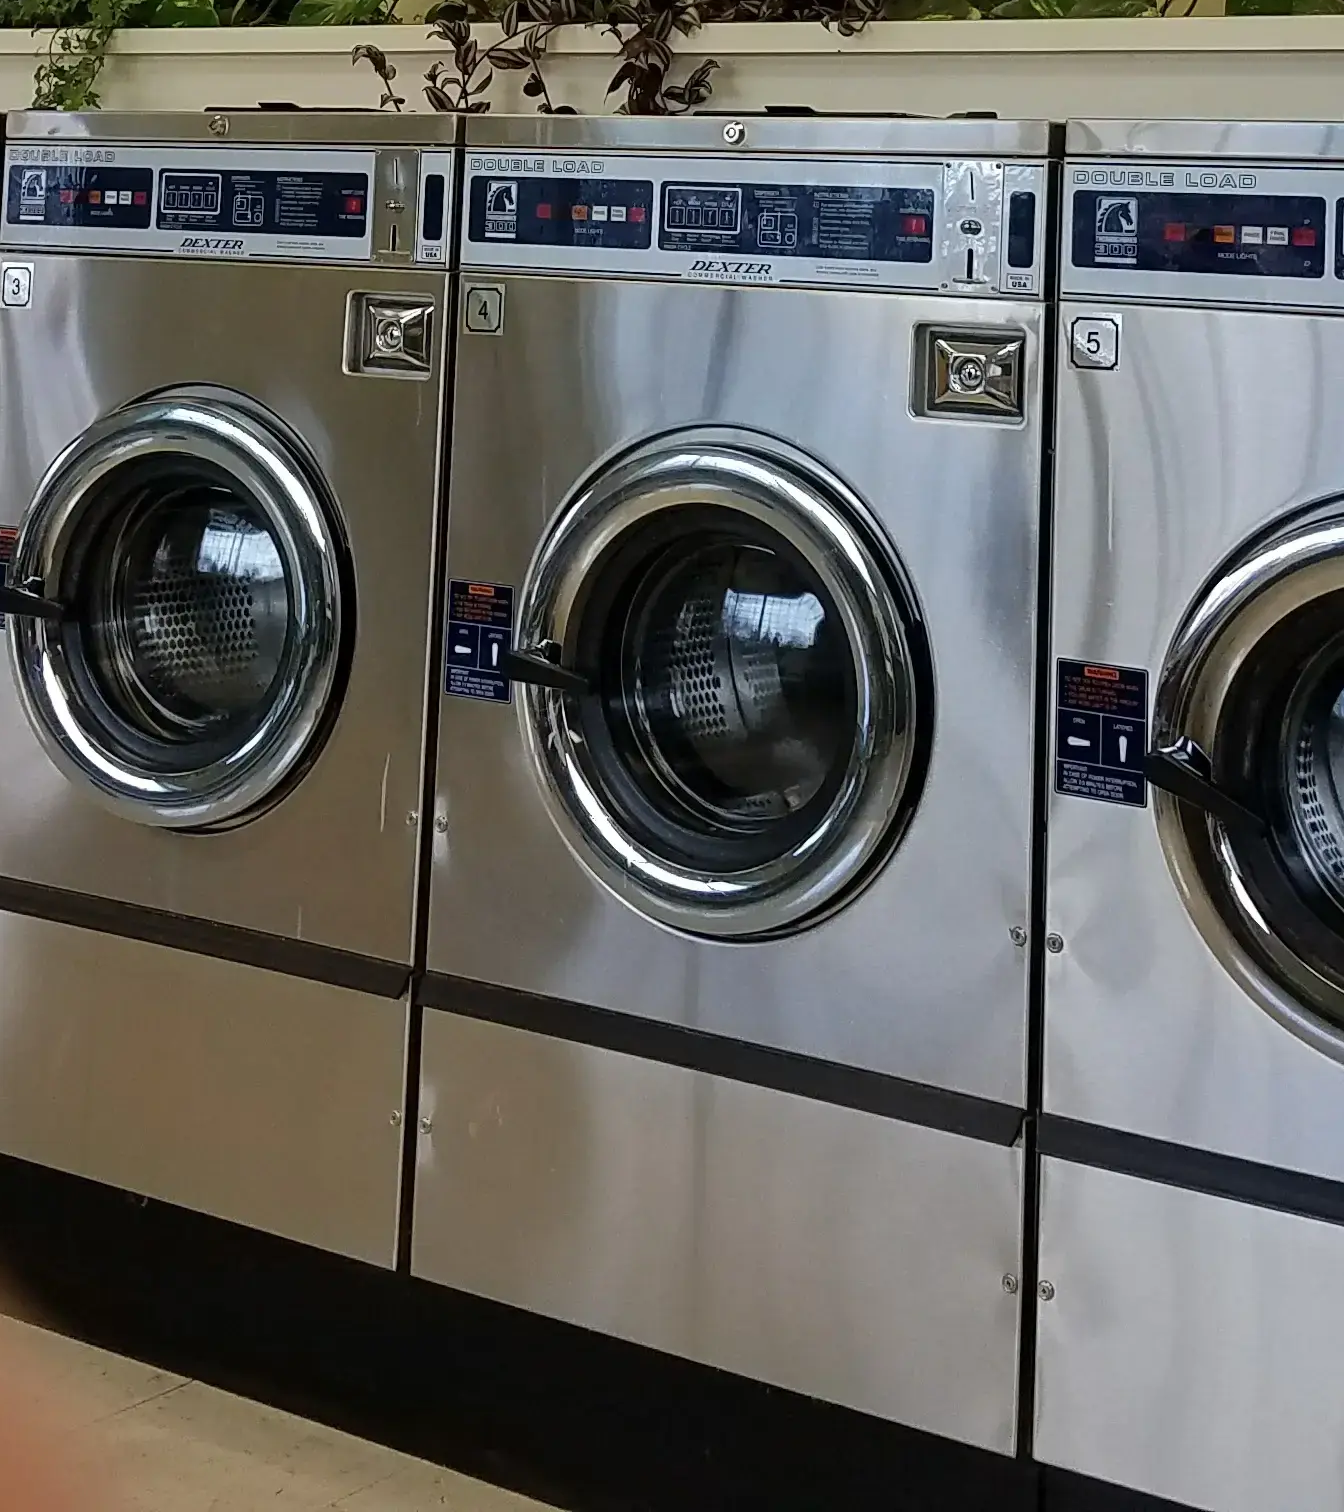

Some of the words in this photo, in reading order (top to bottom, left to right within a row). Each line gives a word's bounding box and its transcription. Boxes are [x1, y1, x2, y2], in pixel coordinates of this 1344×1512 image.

[9, 149, 68, 162] DOUBLE
[75, 150, 116, 163] LOAD
[470, 158, 545, 172] DOUBLE
[552, 160, 605, 173] LOAD
[1073, 170, 1174, 186] DOUBLE
[1185, 173, 1257, 188] LOAD
[180, 237, 244, 249] DEXTER
[1094, 243, 1138, 256] 300
[689, 260, 772, 274] DEXTER
[687, 272, 736, 280] COMMERCIAL
[12, 278, 20, 295] 3
[478, 301, 489, 319] 4
[1086, 331, 1101, 354] 5
